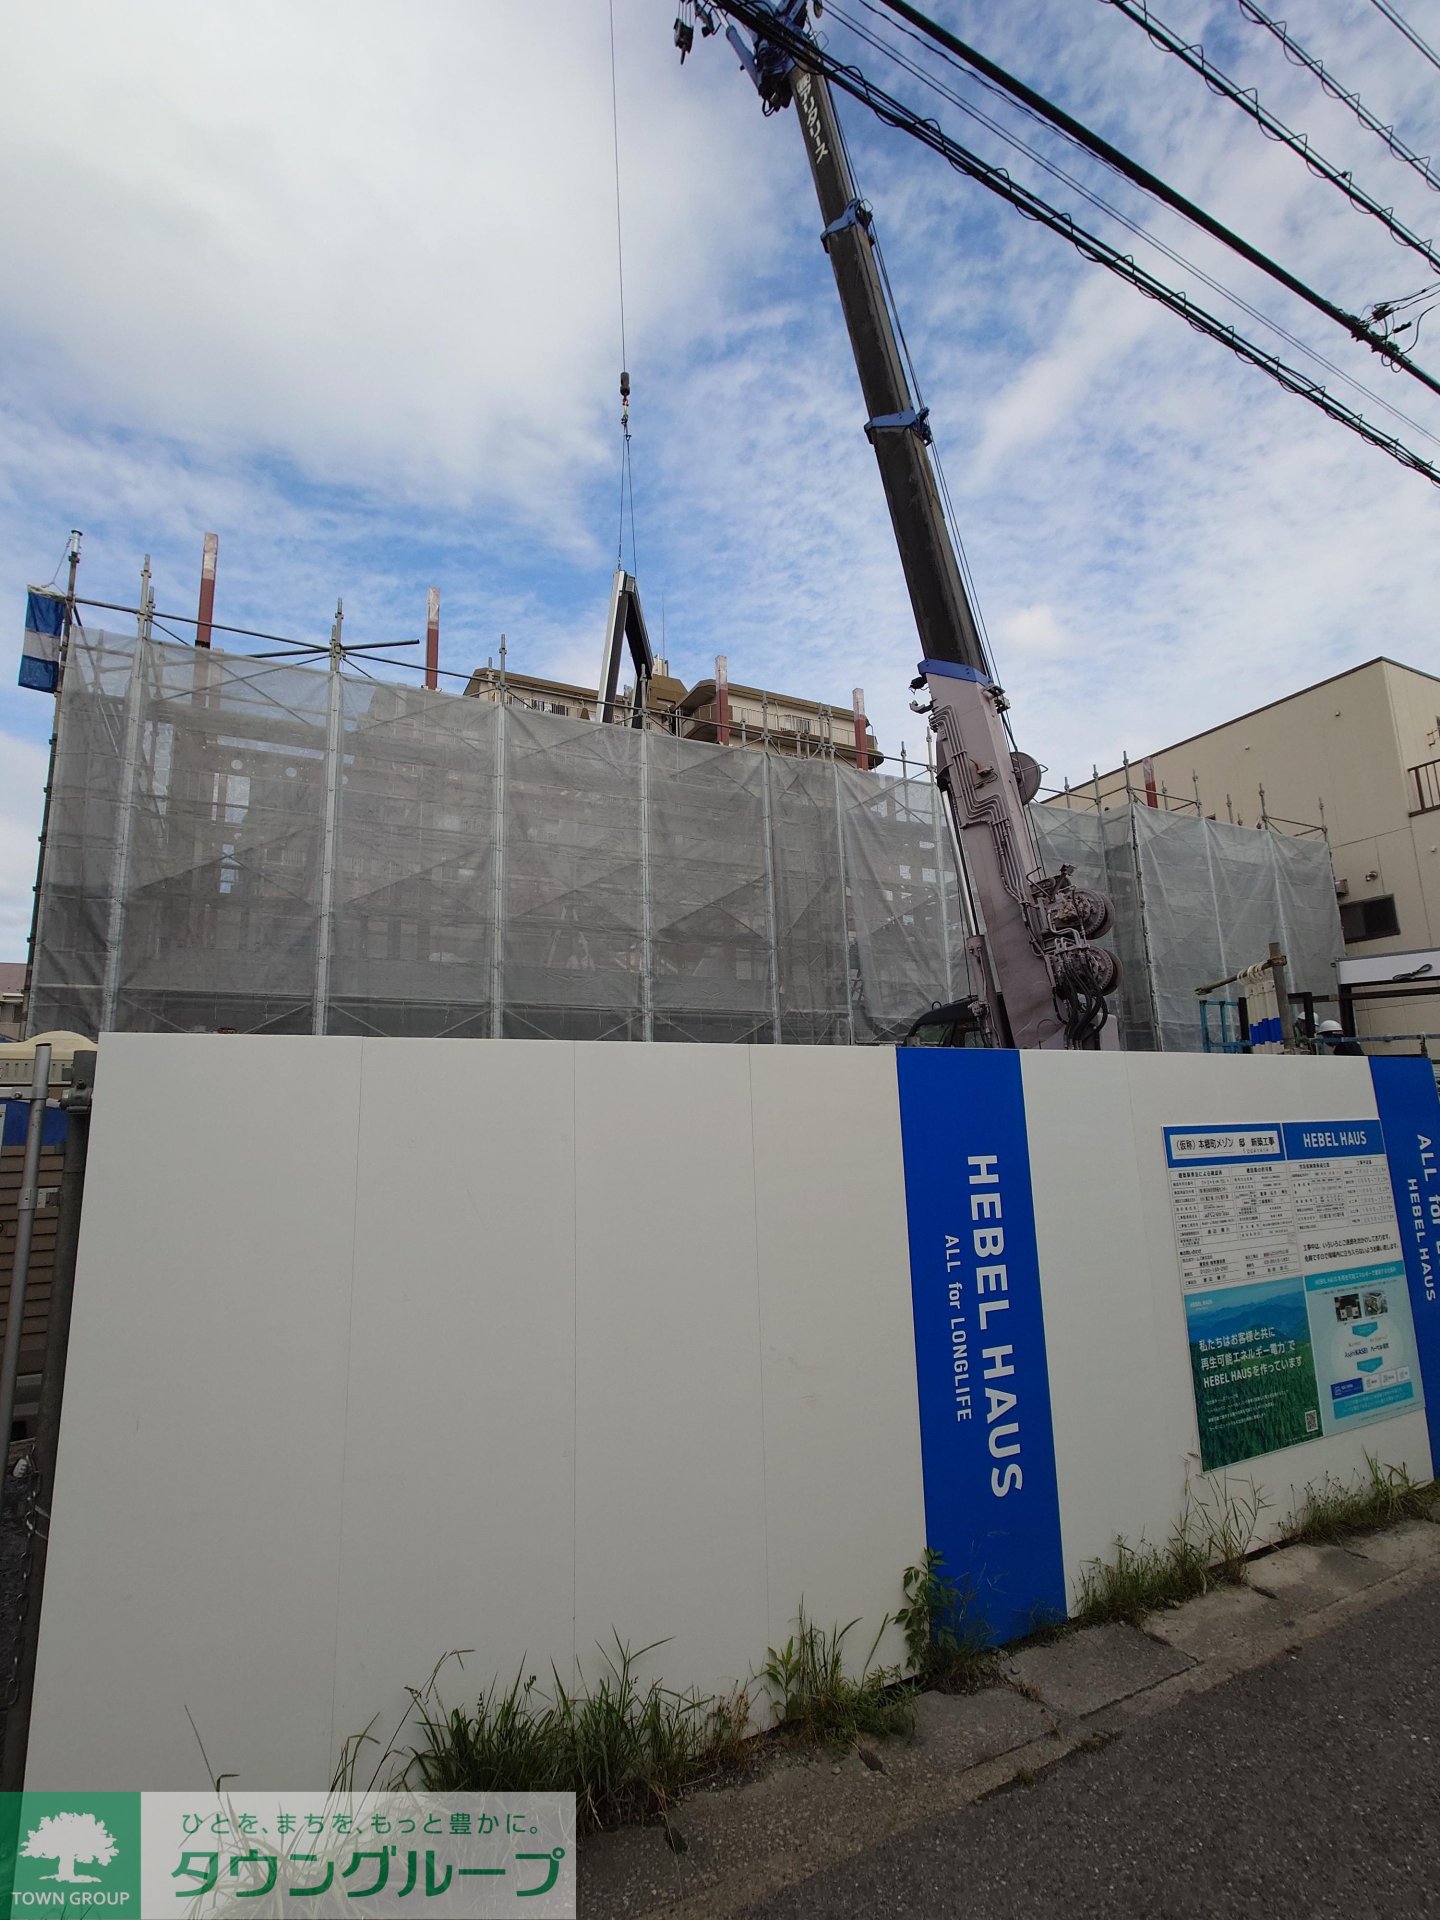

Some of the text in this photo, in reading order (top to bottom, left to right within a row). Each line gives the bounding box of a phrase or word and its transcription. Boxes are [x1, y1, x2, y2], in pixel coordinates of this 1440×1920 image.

[1303, 1130, 1368, 1148] HEBEL HAUS
[1417, 1134, 1437, 1182] ALL
[1407, 1178, 1426, 1243] HEBEL
[1419, 1247, 1437, 1302] HAUS
[944, 1235, 972, 1422] ALL for LONGLIFE
[967, 1155, 1023, 1497] HEBEL HAUS
[1199, 1327, 1276, 1352] 私たちはお客様と共に
[1203, 1373, 1230, 1389] HEBEL
